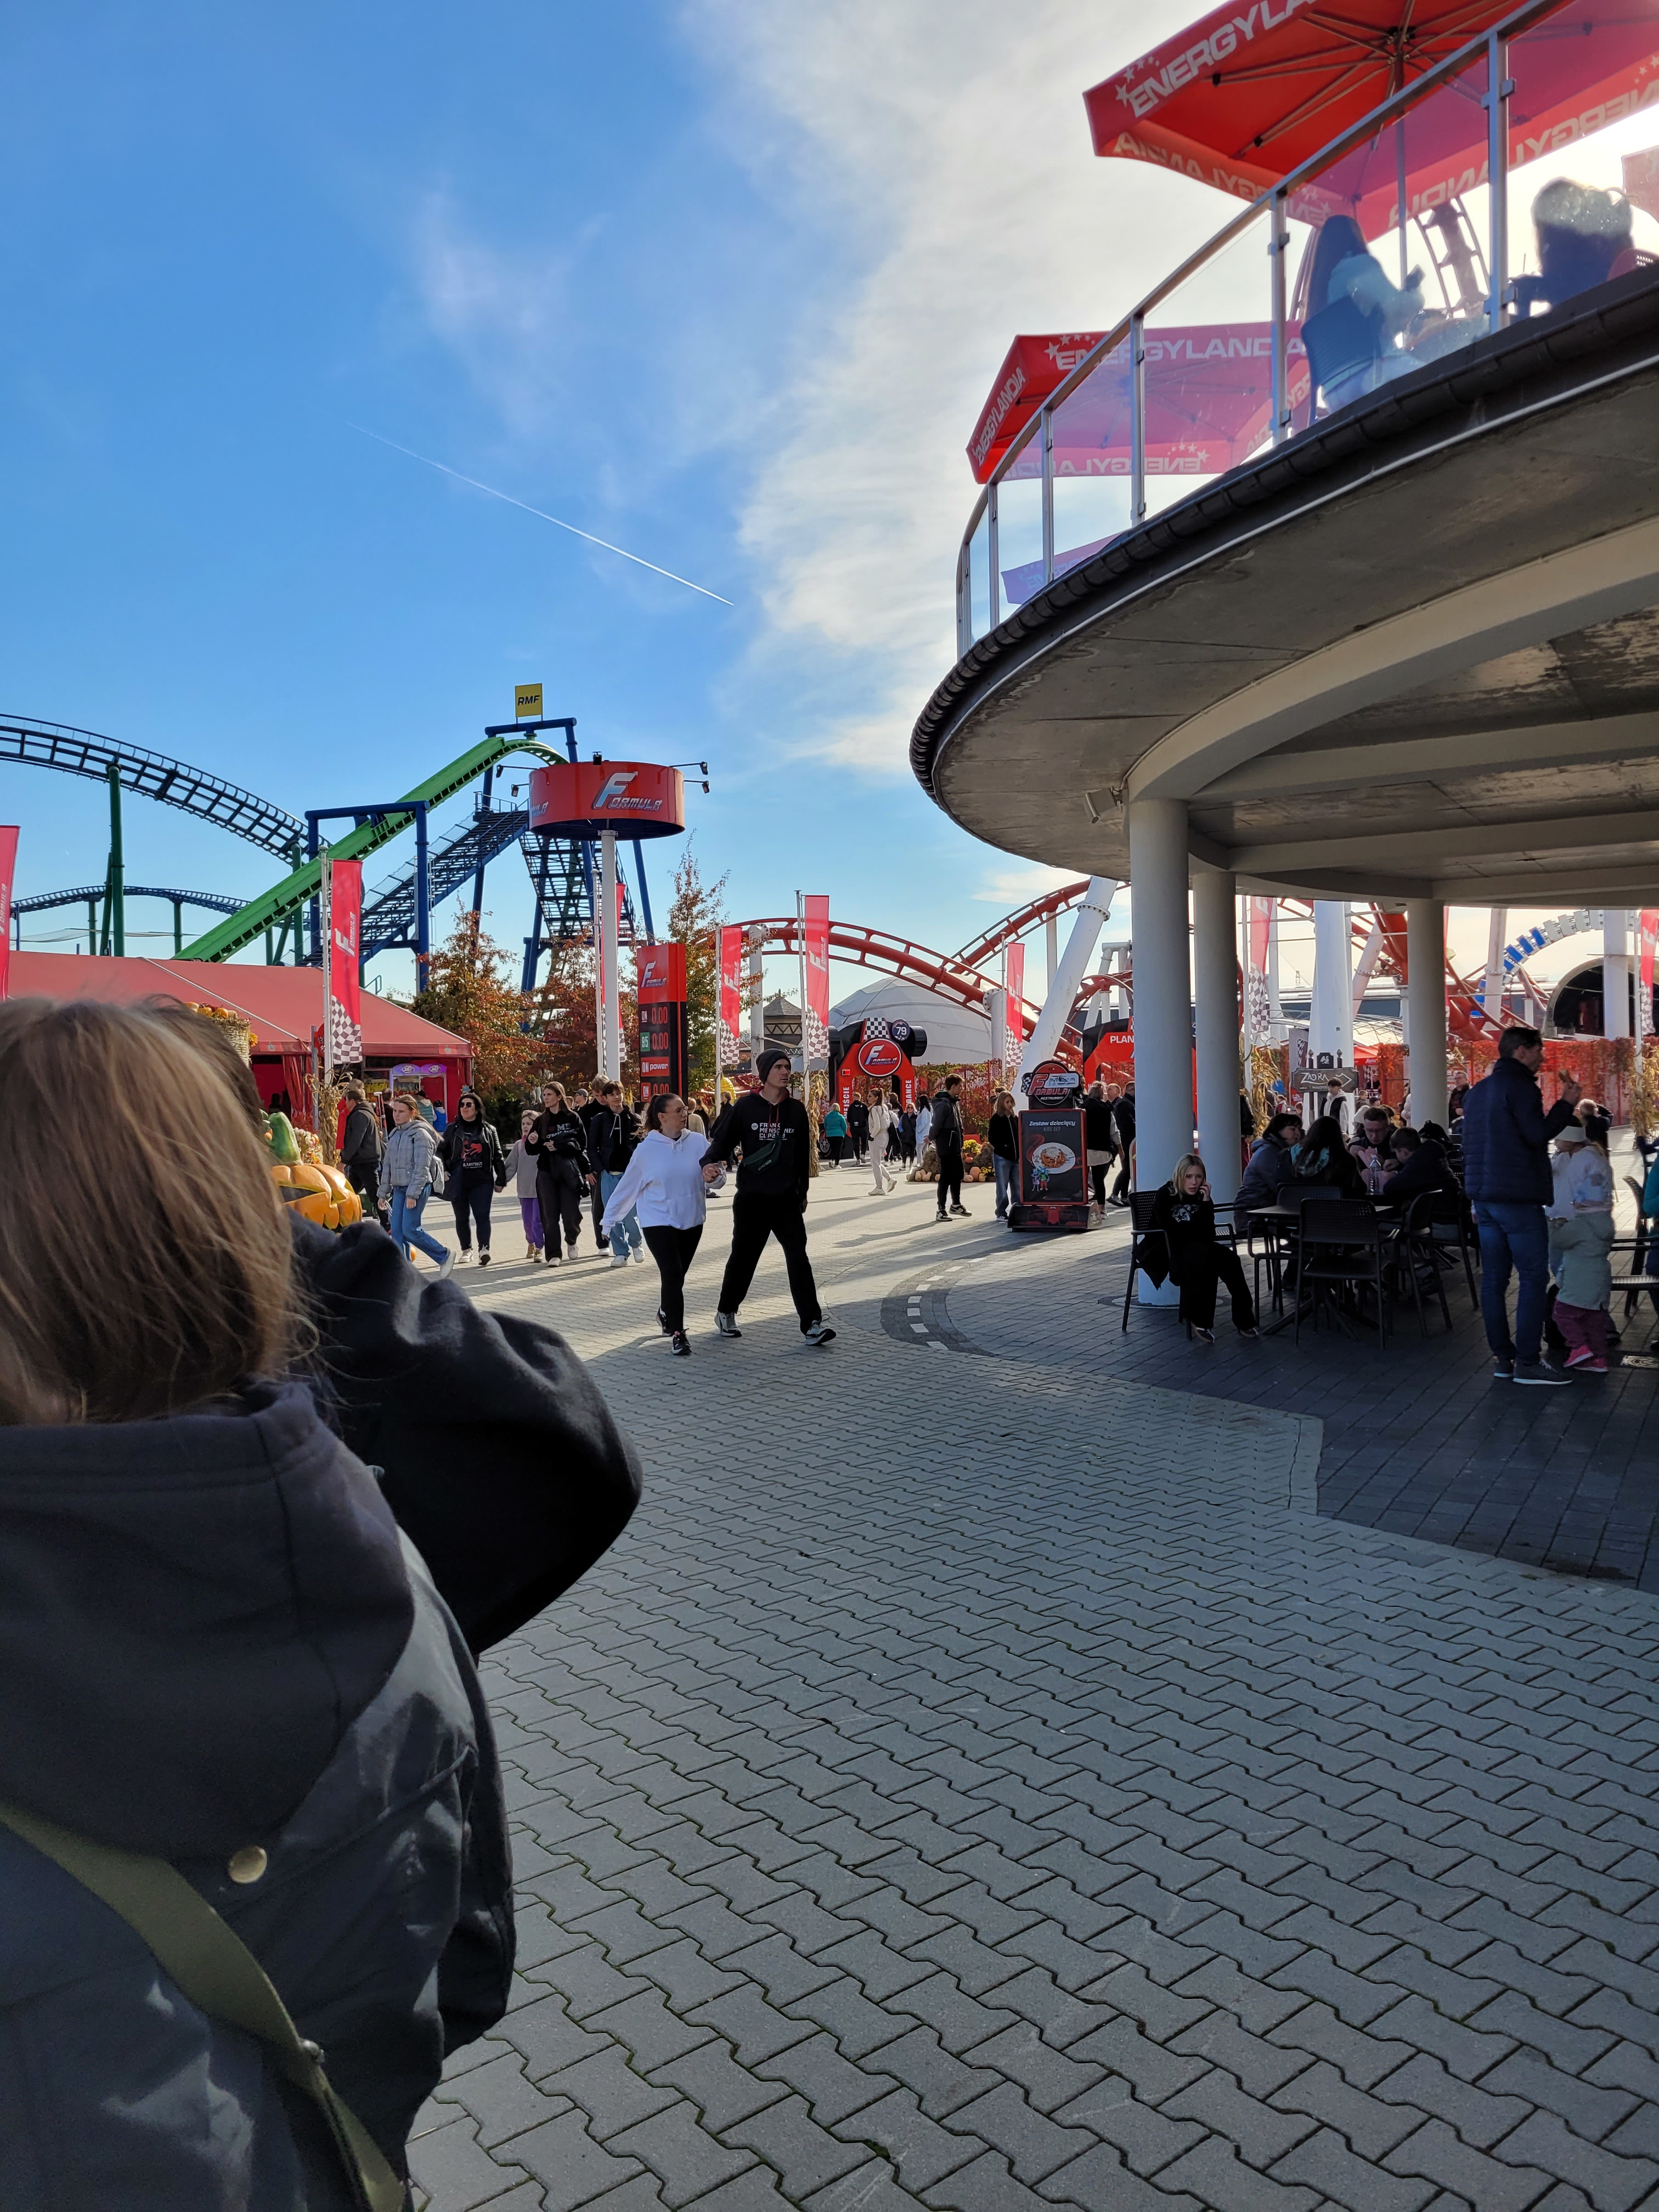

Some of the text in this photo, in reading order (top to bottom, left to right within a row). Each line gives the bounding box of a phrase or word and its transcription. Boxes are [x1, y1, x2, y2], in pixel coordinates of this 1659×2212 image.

[1128, 0, 1317, 119] ENERGYLA
[976, 366, 1026, 467] ENERGYLANDIA
[518, 695, 540, 706] RMF
[591, 771, 662, 811] FORMULA
[335, 911, 356, 957] FORMULA
[809, 936, 826, 972] FORMULA
[641, 1007, 668, 1025] ON 0.00
[896, 1026, 907, 1035] 79
[641, 1032, 669, 1050] 95 0.00
[642, 1062, 669, 1073] ON power
[1027, 1073, 1069, 1096] FORMULA
[1300, 1072, 1329, 1085] ZADRA
[643, 1086, 649, 1097] ON
